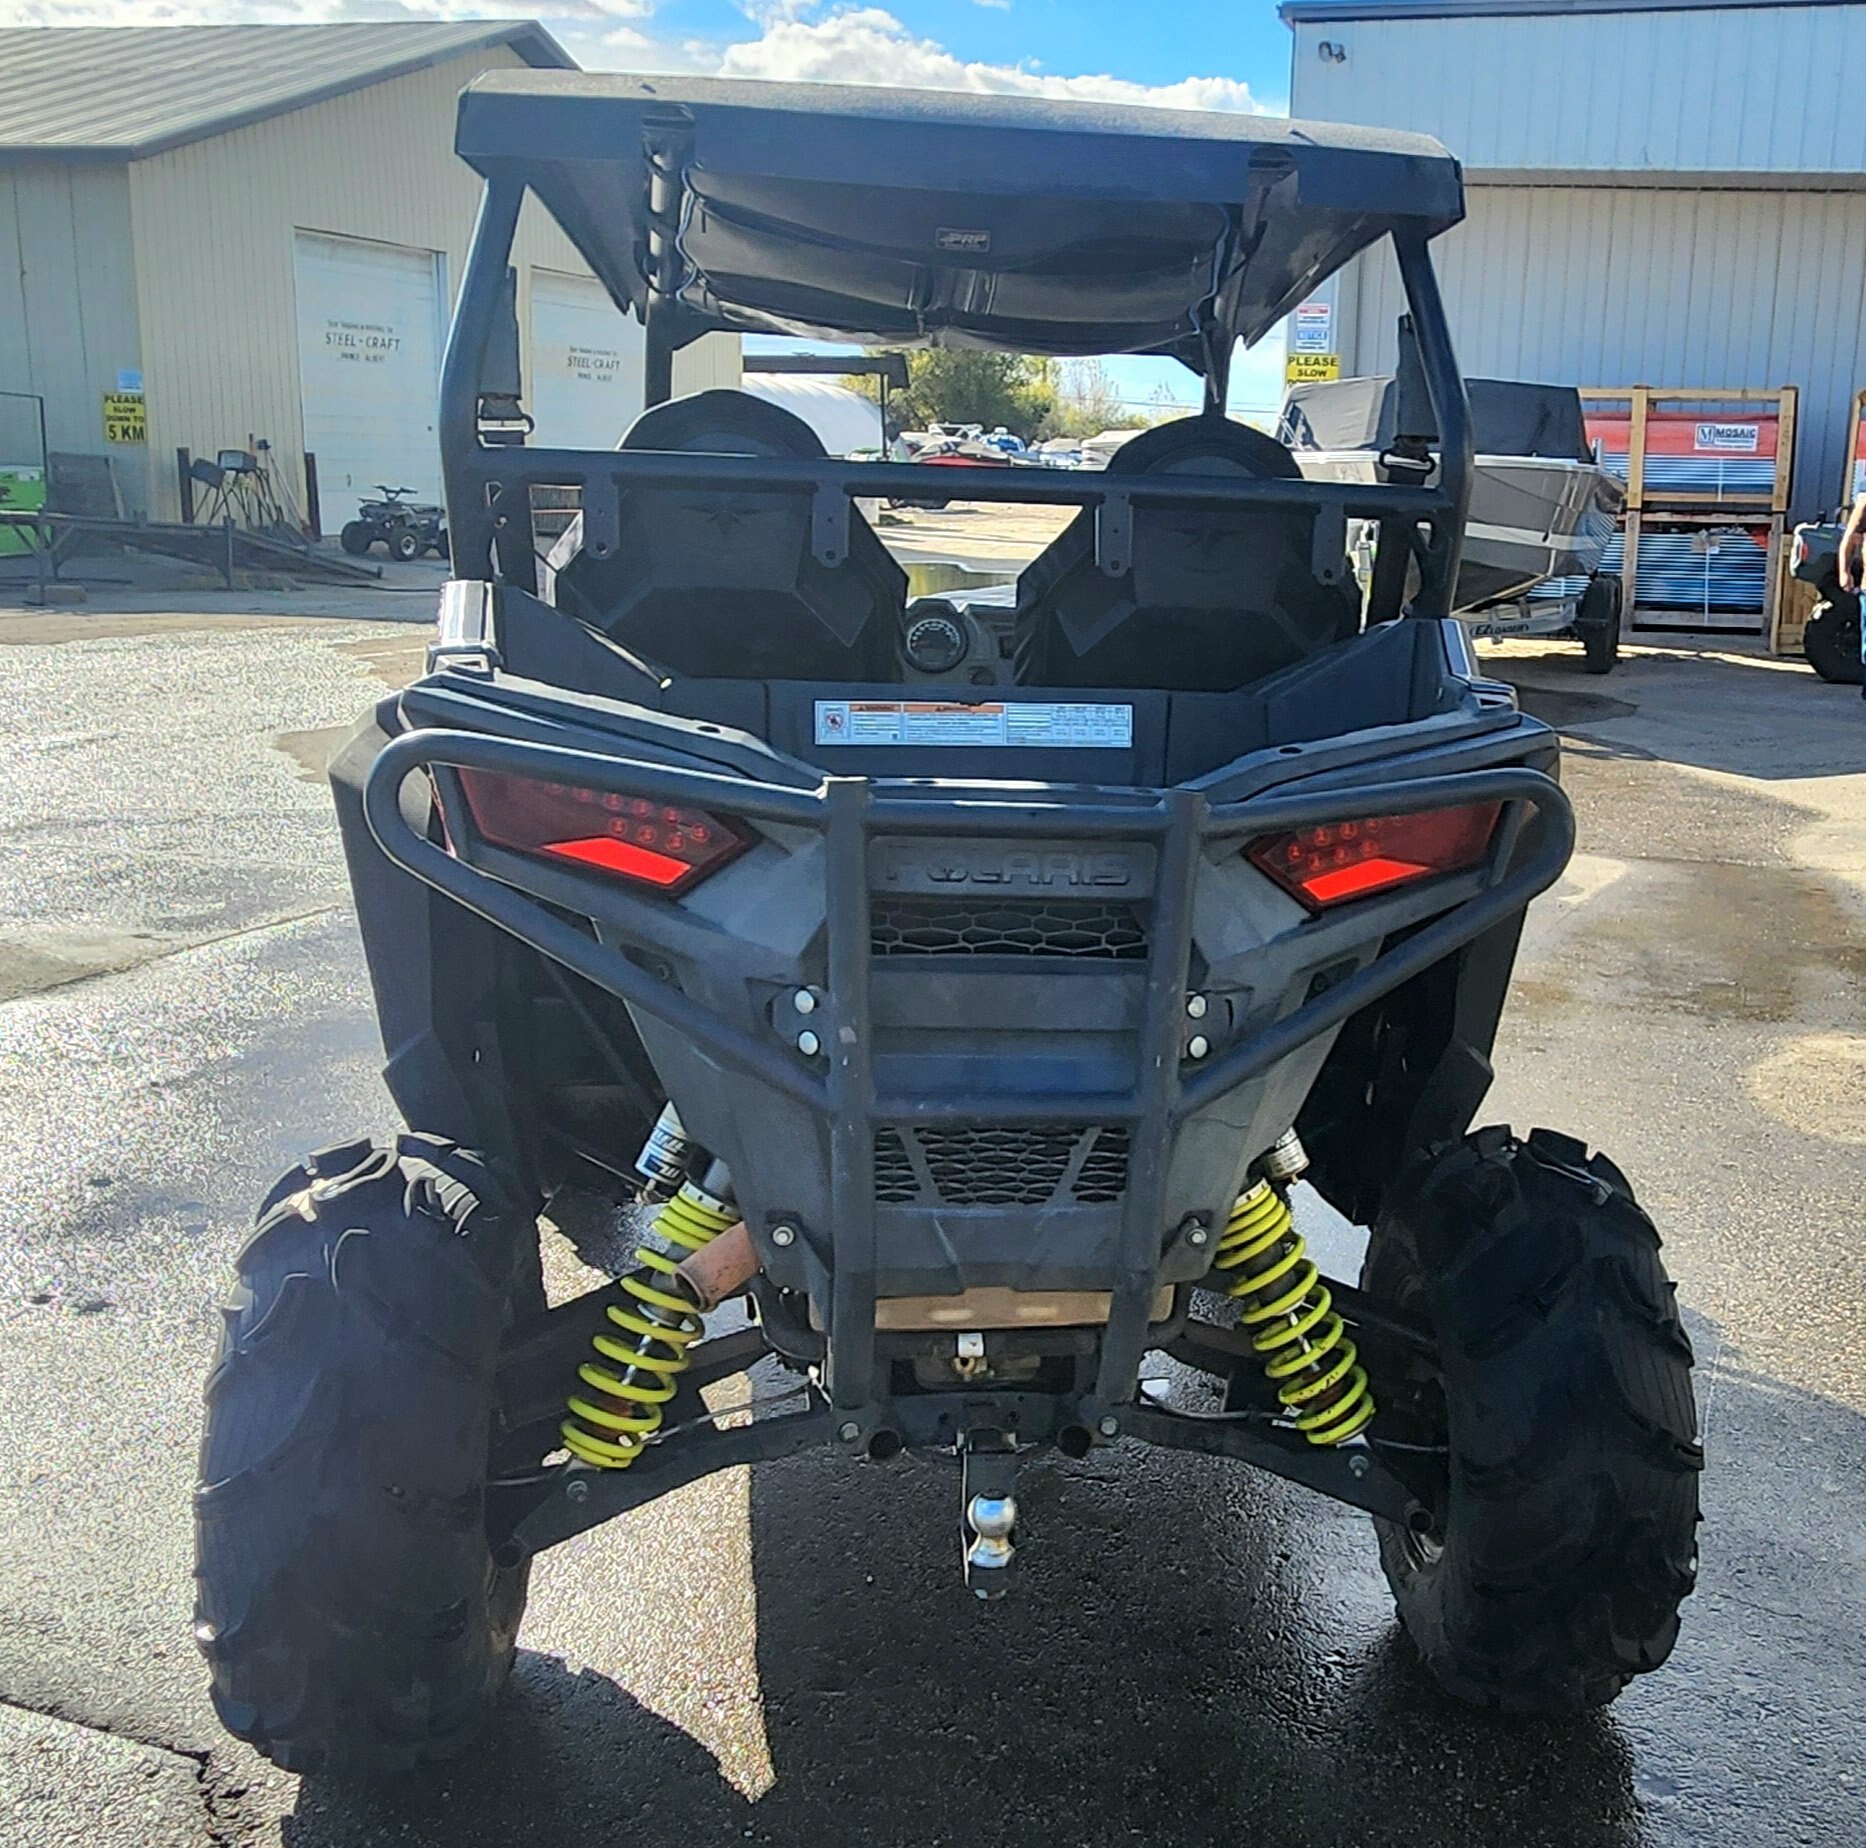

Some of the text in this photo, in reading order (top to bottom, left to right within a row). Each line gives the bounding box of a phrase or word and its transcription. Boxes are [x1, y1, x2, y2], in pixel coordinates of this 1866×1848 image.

[1287, 356, 1339, 367] PLEASE
[1297, 369, 1328, 377] SLOW
[104, 394, 144, 405] PLEASE
[113, 406, 137, 414] SLOW
[108, 424, 145, 441] 5 KM
[1716, 427, 1757, 438] MOSAIC
